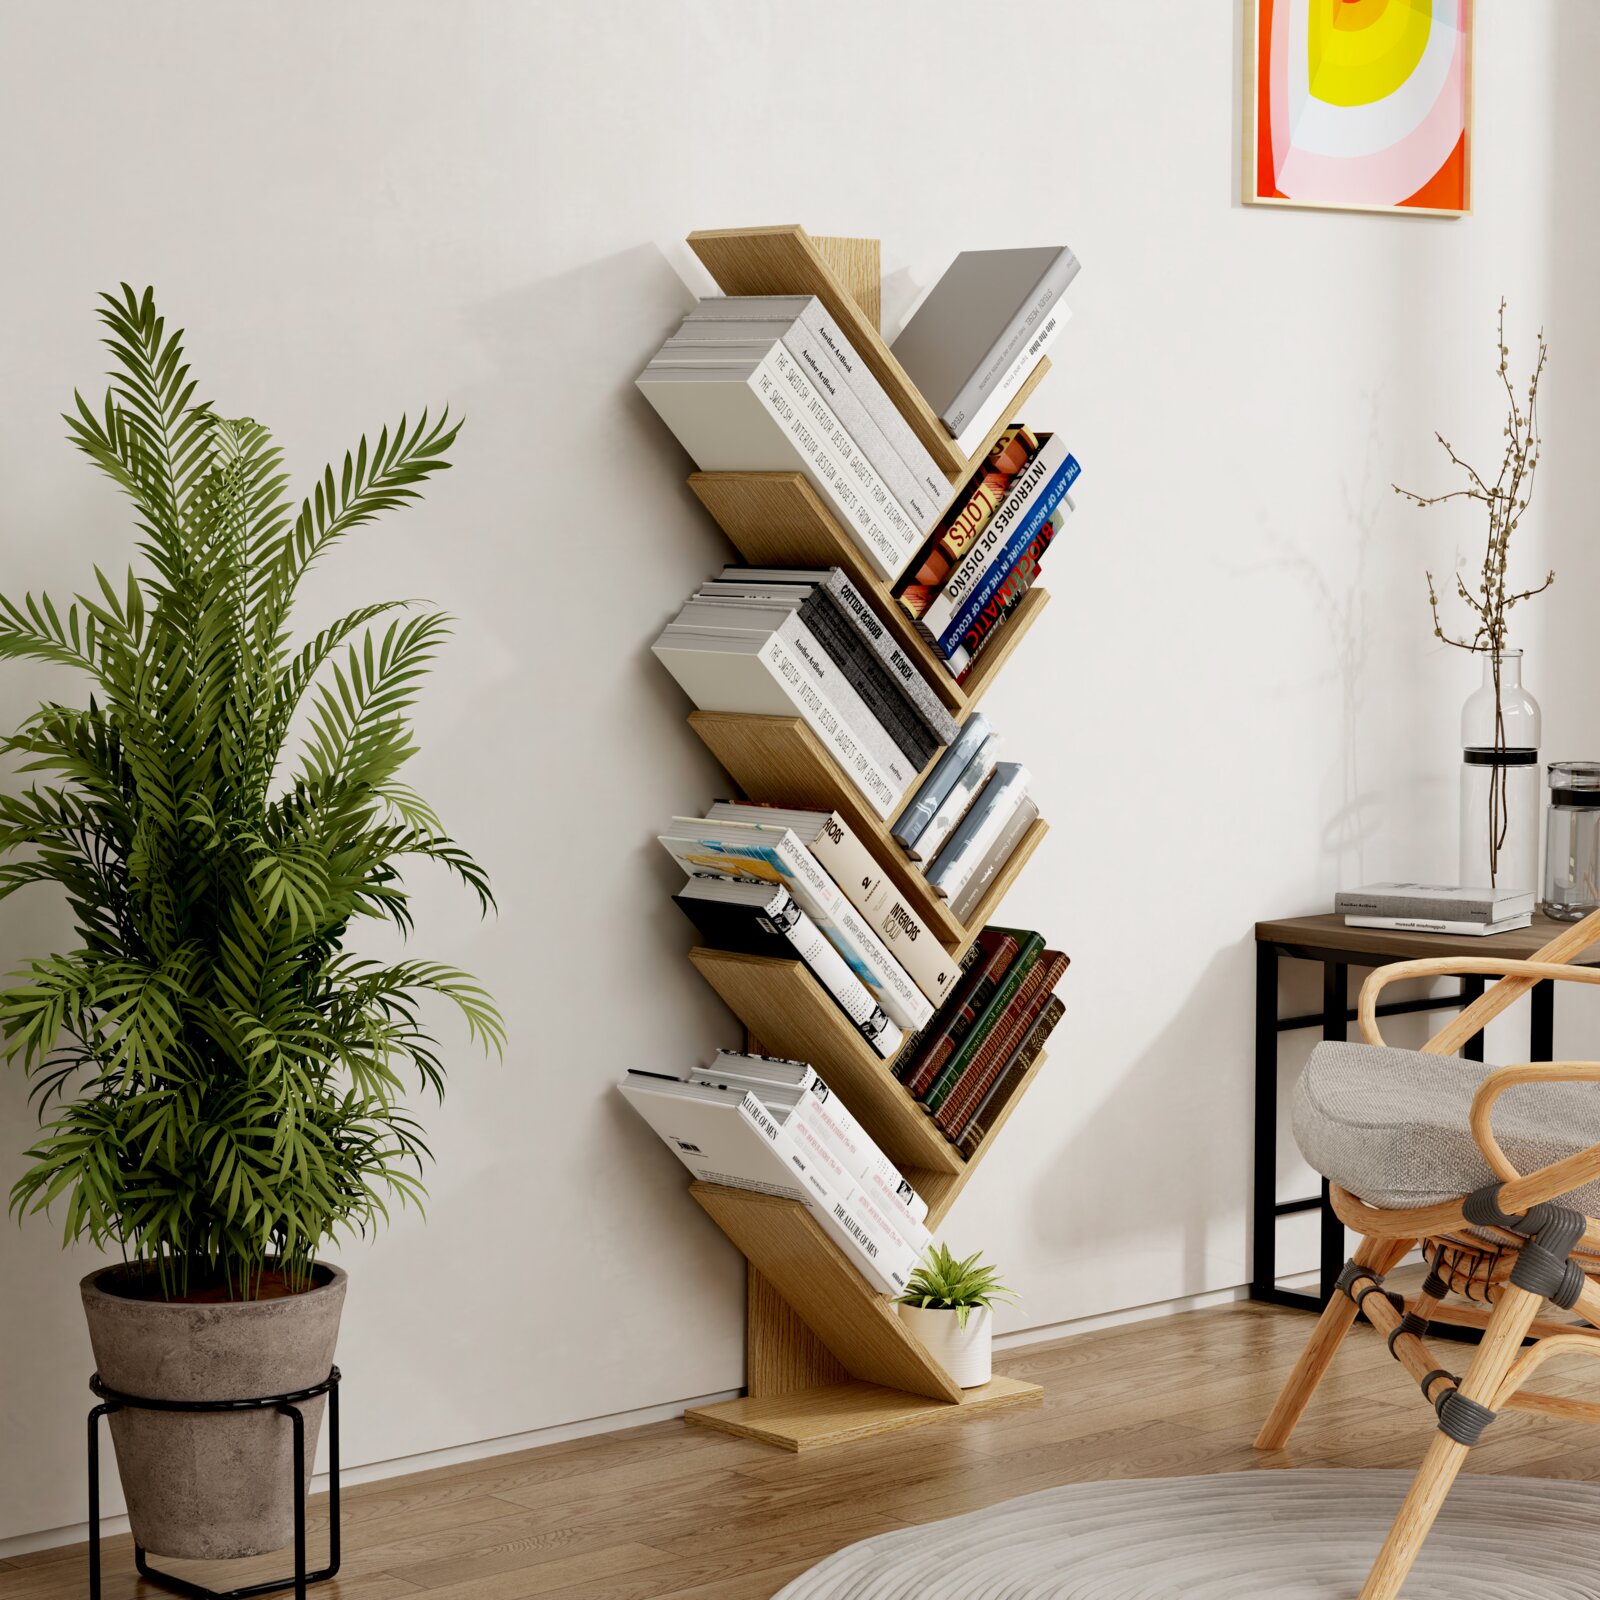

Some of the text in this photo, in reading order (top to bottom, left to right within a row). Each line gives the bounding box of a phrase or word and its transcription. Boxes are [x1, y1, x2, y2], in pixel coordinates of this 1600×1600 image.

[818, 327, 852, 373] Another ArtBook
[1029, 318, 1056, 355] ride the bike
[802, 349, 835, 396] Another ArtBook
[758, 374, 899, 566] THE SWEDISH INTERIOR DESIGN GADGETS FROM EVERMOTION
[775, 353, 914, 544] THE SWEDISH INTERIOR DESIGN GADGETS FROM EVERMOTION
[950, 490, 988, 548] Lofts
[994, 461, 1047, 533] INTERIORES
[945, 463, 1078, 652] THE ART OF ARCHITECTURE IN THE AGE OF ECOLOGY
[980, 530, 998, 551] DE
[965, 523, 1055, 648] BIOCLIMATIC
[794, 638, 824, 678] Another ArtBook
[769, 644, 893, 806] THE SWEDISH INTERIOR DESIGN GADGETS FROM EVERMOTION
[881, 912, 900, 942] NOW!
[890, 902, 920, 941] INTERIORS
[758, 1115, 768, 1128] OF
[764, 1122, 779, 1140] MEN
[833, 1203, 846, 1219] THE
[842, 1215, 862, 1239] ALLURE
[859, 1234, 869, 1246] OF
[864, 1240, 879, 1258] MEN
